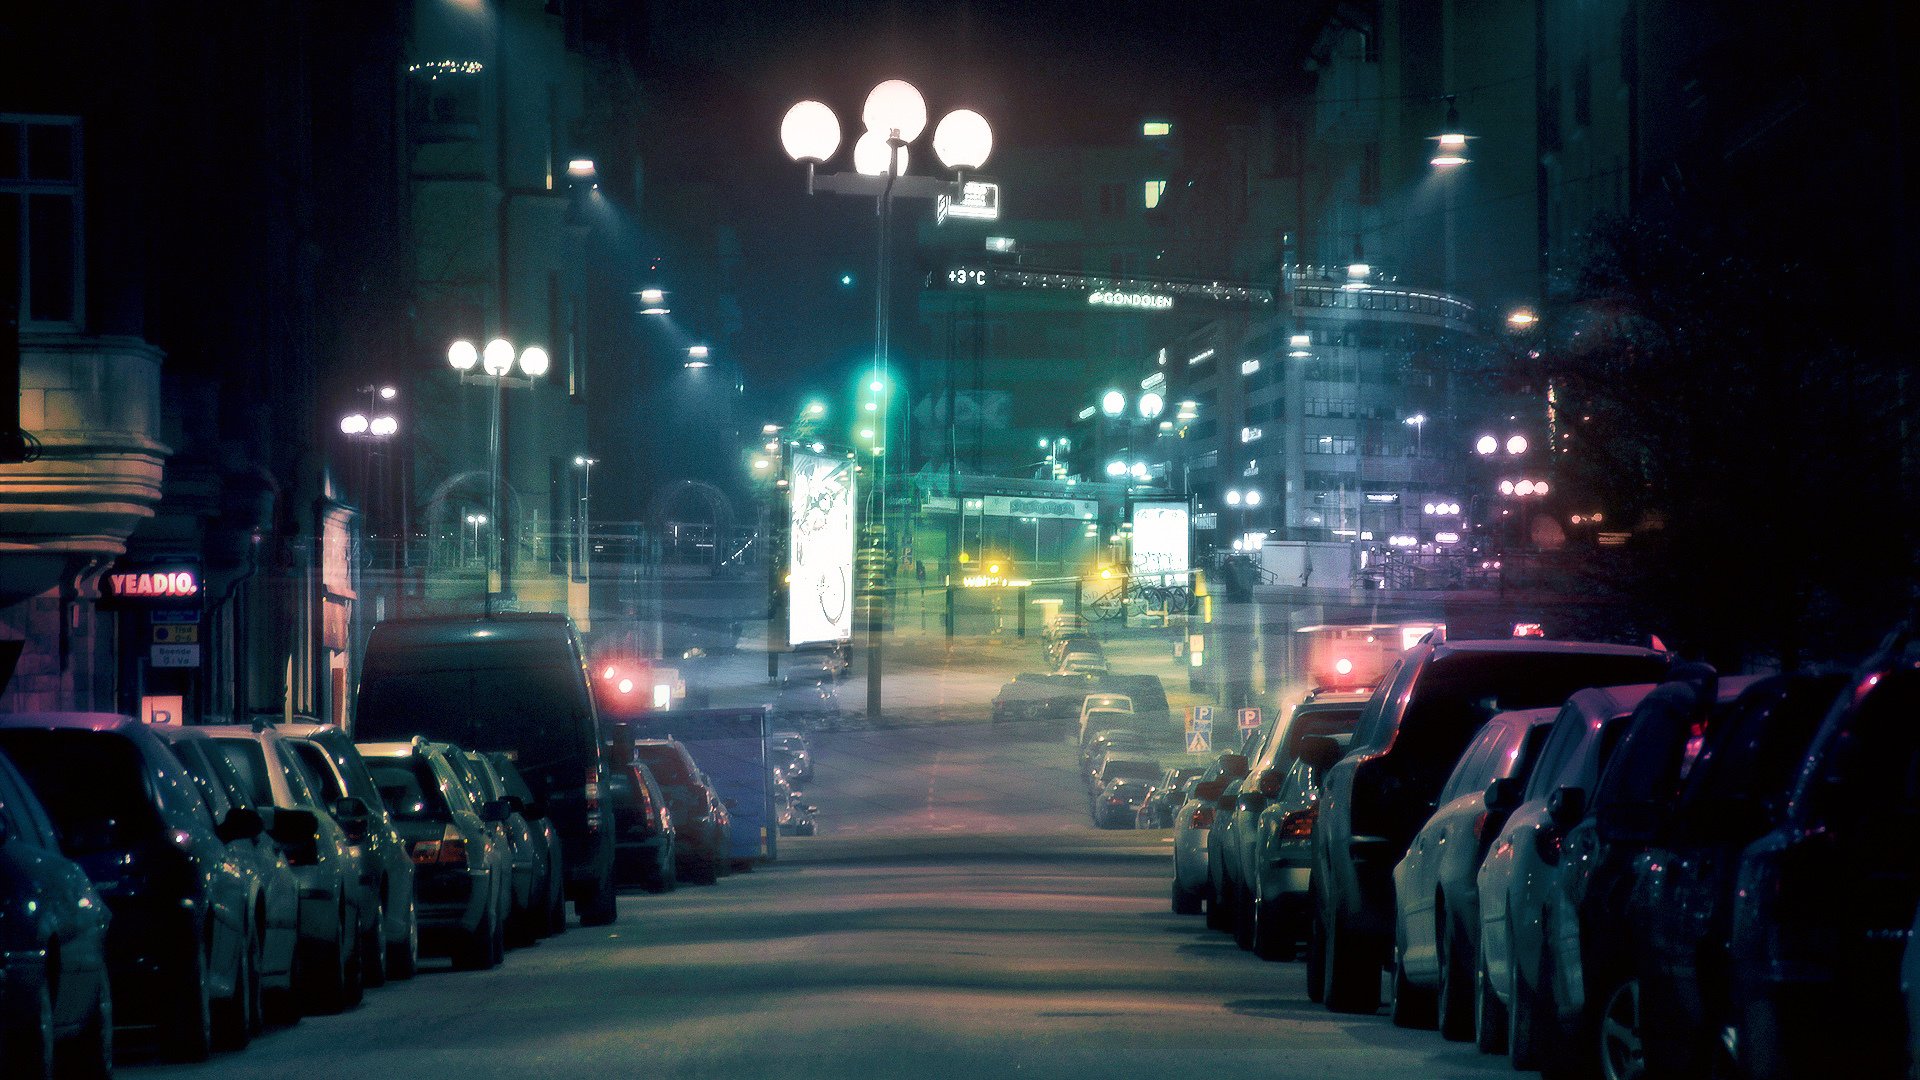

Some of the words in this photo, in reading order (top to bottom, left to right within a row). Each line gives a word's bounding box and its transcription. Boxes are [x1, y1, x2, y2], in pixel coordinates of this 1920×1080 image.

[948, 269, 986, 286] +3°C
[1103, 292, 1174, 309] GONDOLEN
[1199, 707, 1209, 720] P
[1244, 710, 1256, 726] P
